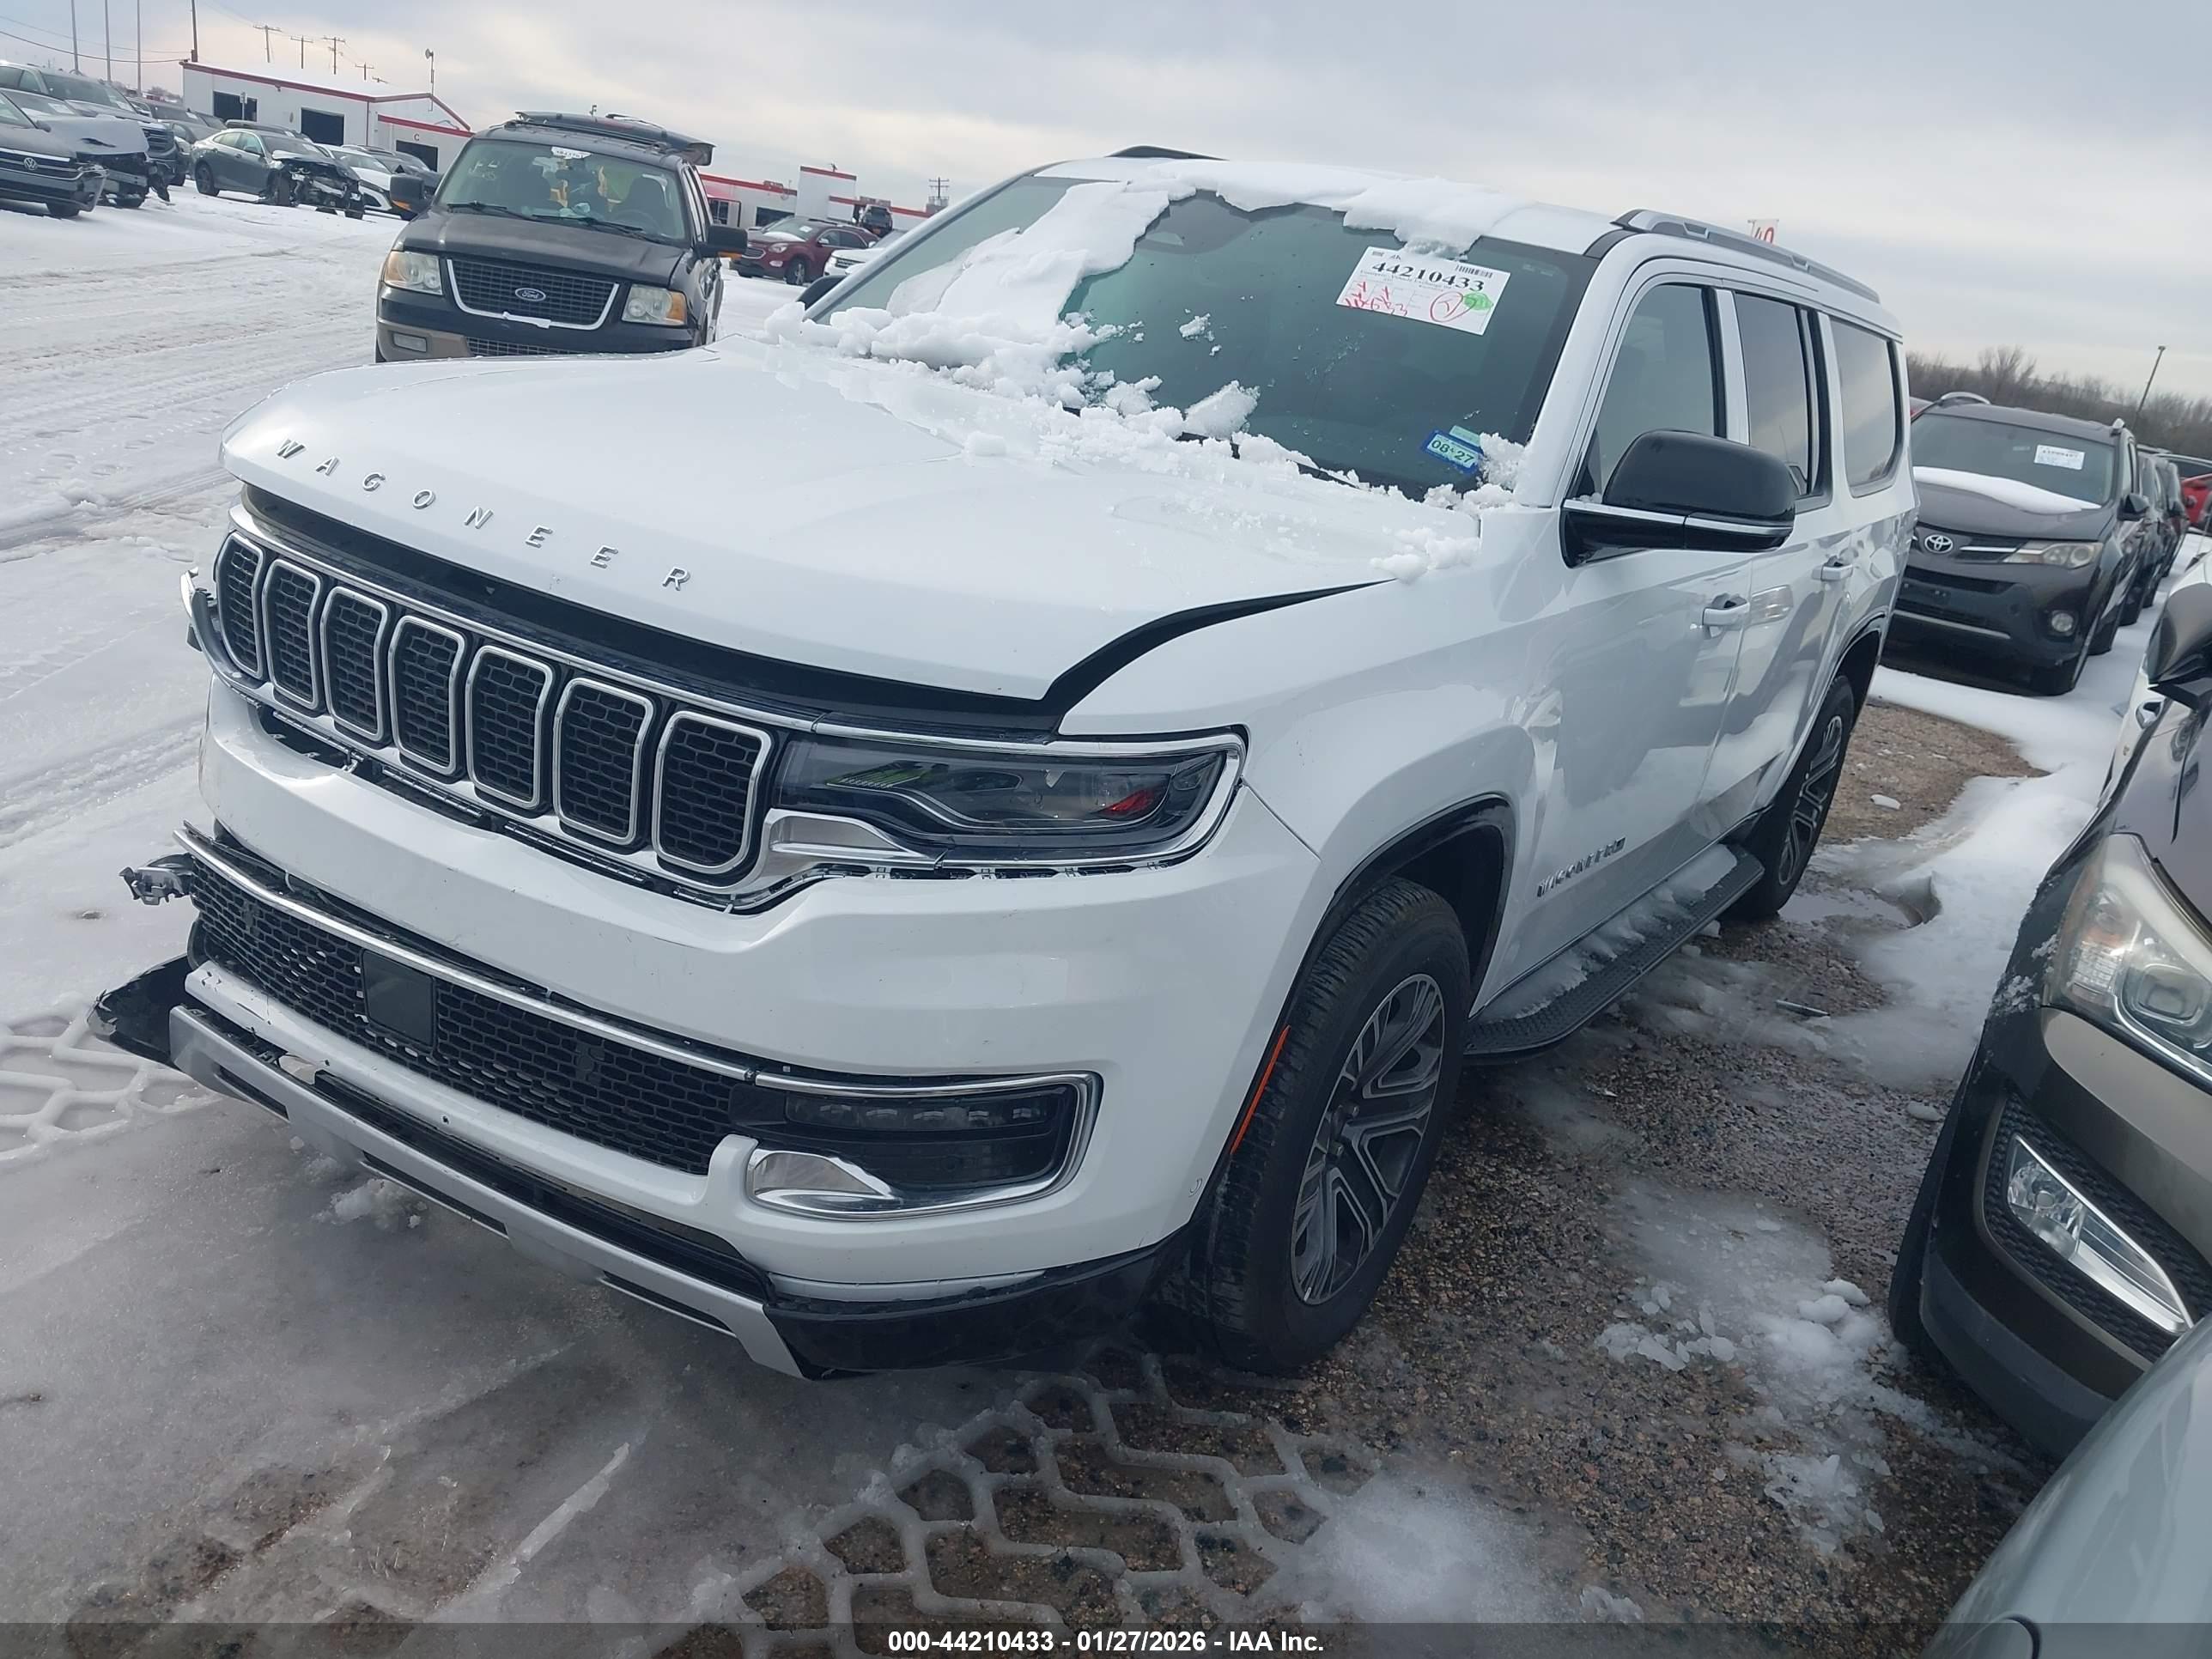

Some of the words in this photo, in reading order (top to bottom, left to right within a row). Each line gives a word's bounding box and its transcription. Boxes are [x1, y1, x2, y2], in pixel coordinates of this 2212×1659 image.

[1372, 262, 1485, 292] 44210433
[521, 290, 539, 299] Ford
[276, 438, 692, 591] WAGONEER
